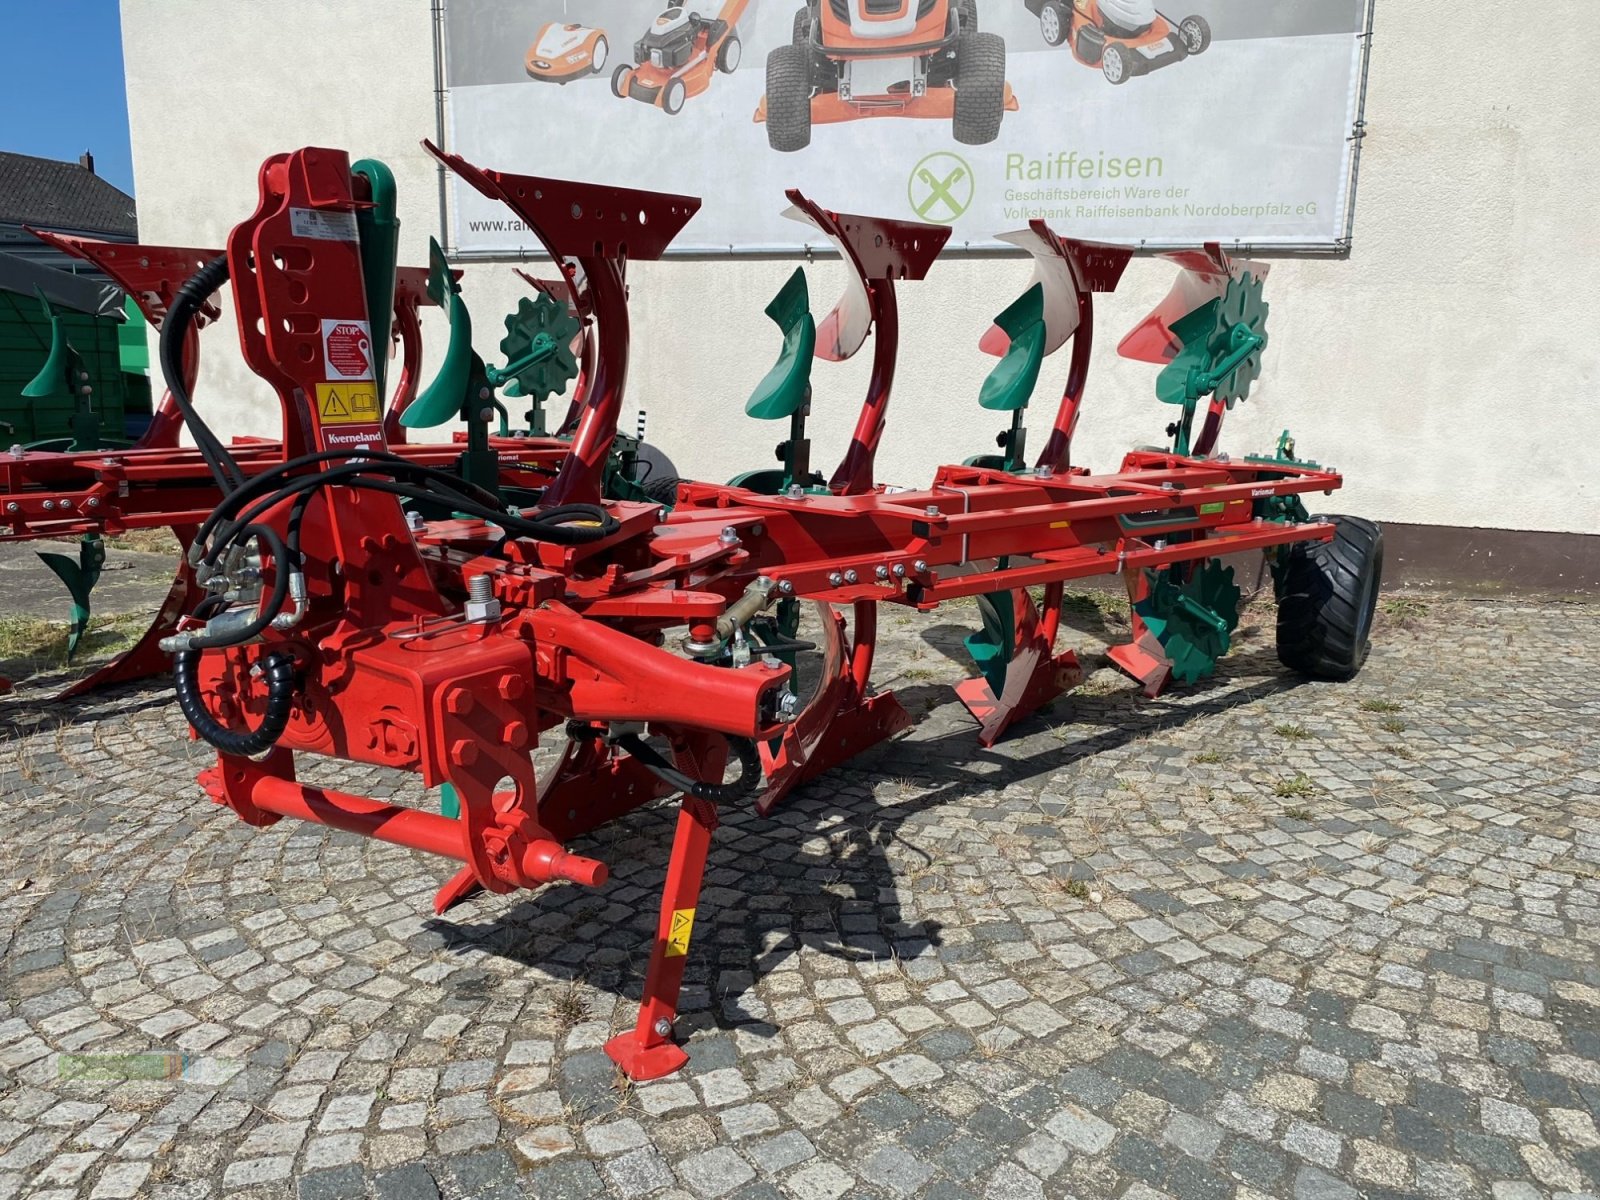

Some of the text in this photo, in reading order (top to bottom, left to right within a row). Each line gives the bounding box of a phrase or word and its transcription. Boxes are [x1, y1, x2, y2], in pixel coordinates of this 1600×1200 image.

[1005, 151, 1163, 180] Raiffeisen
[1004, 185, 1190, 201] Geschäftsbereich Ware der
[1003, 201, 1317, 219] Volksbank Raiffeisenbank Nordoberpfalz eG
[328, 431, 382, 444] Kverneland
[497, 453, 519, 461] riomat
[1251, 487, 1275, 497] Variomat
